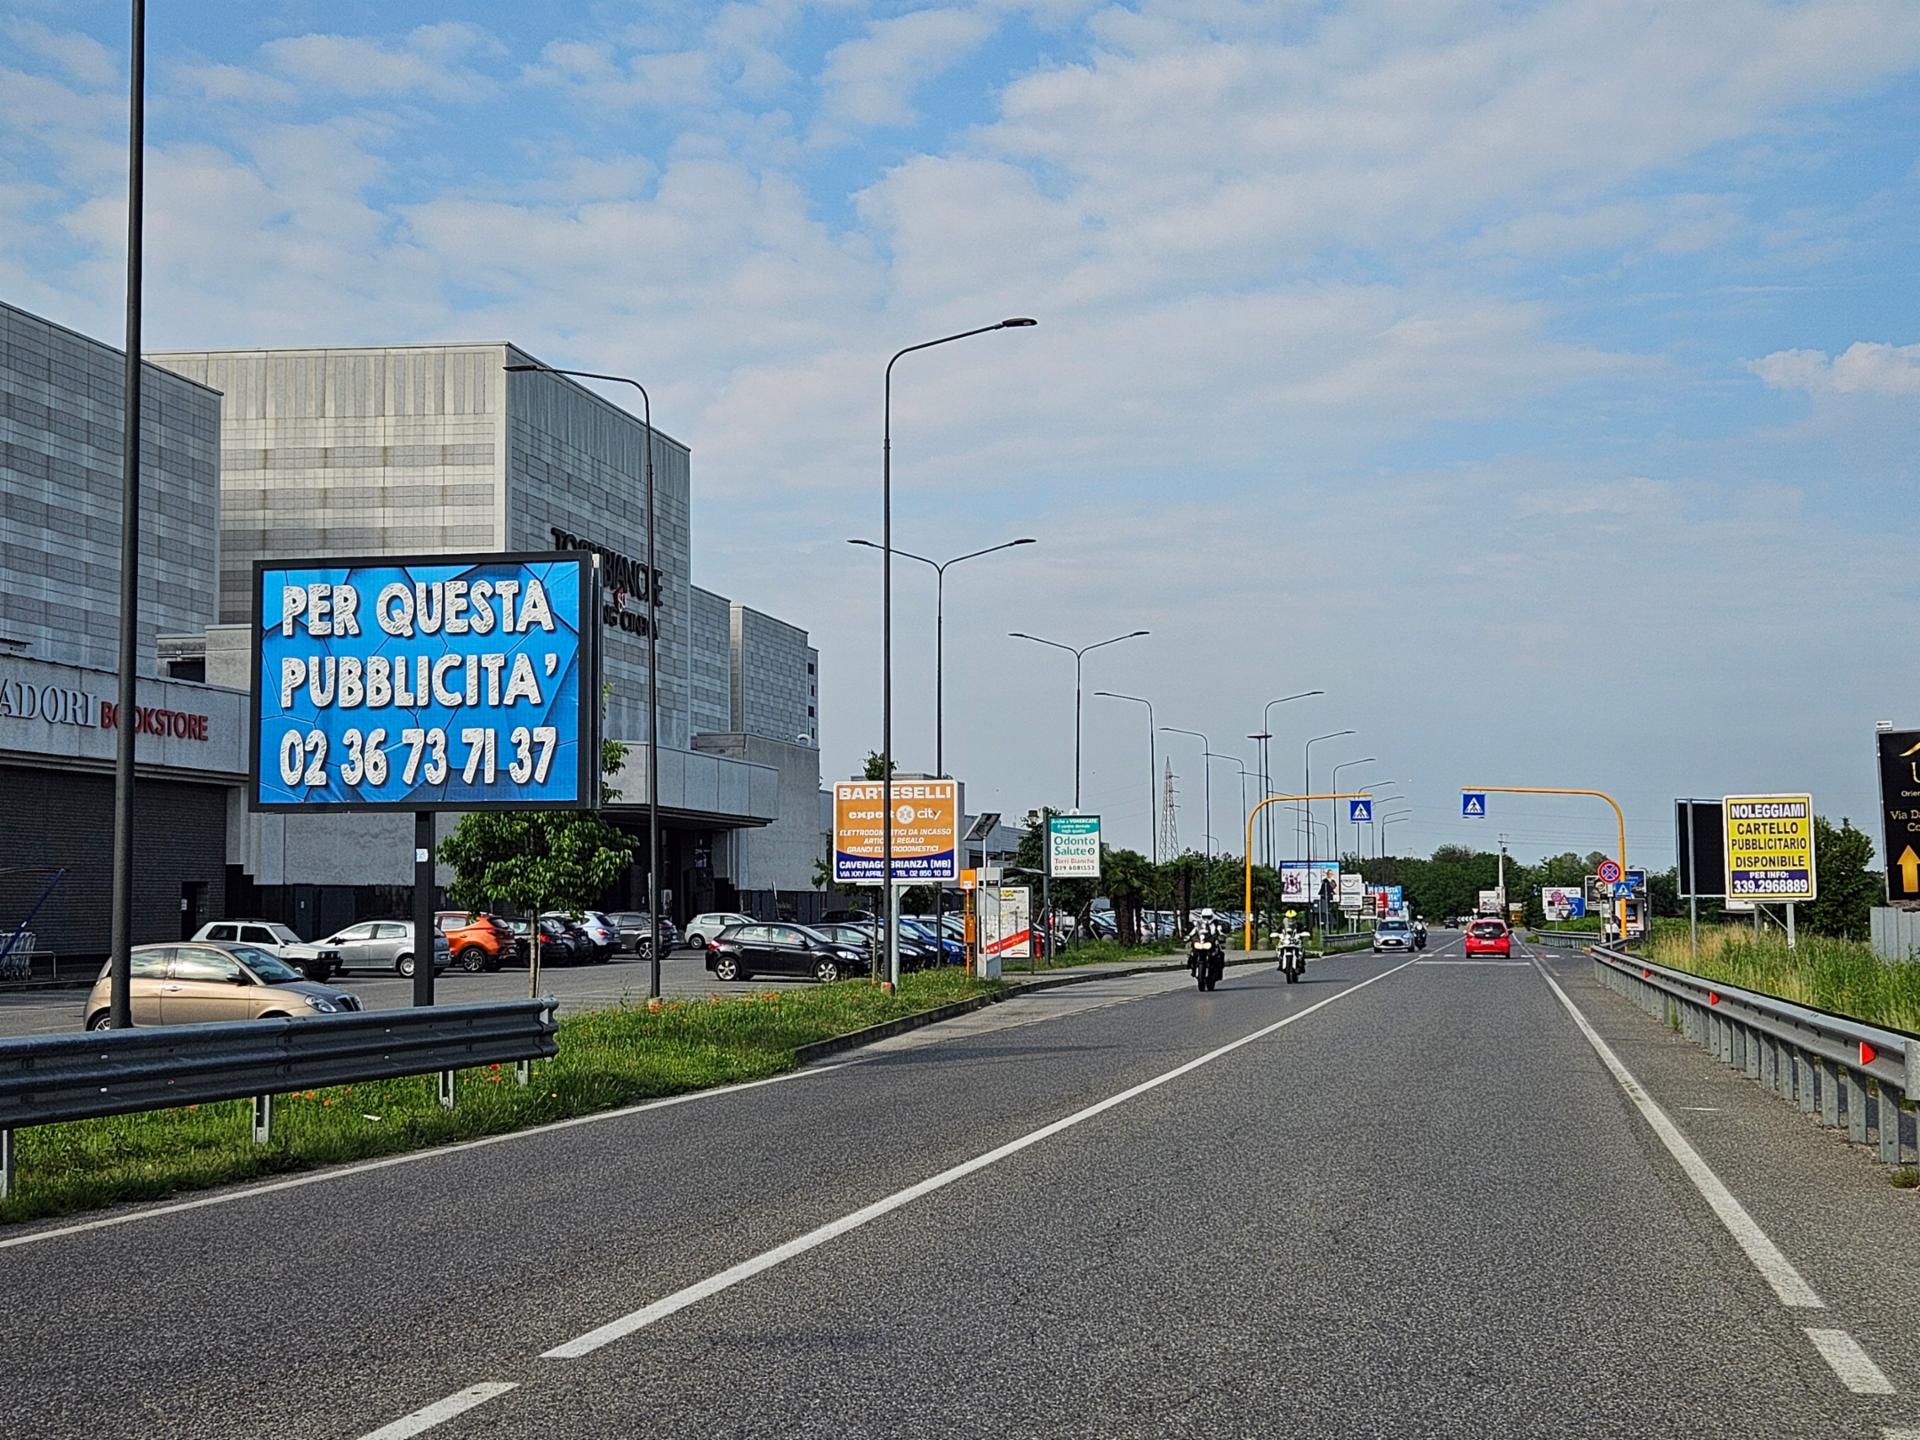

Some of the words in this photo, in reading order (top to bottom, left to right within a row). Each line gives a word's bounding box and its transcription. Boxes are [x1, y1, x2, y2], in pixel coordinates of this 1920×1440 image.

[282, 583, 360, 637] PER
[376, 579, 554, 637] QUESTA
[280, 729, 327, 786] 02
[340, 728, 387, 786] 36
[402, 727, 447, 785] 73
[462, 727, 495, 784] 71
[508, 726, 556, 784] 37
[848, 810, 895, 819] expet
[917, 807, 942, 820] city
[1731, 803, 1805, 818] NOLEGGIAMI
[1890, 810, 1908, 820] Via
[1737, 822, 1799, 835] CARTELLO
[1054, 836, 1096, 845] Odonto
[1731, 838, 1807, 850] PUBBLICITARIO
[1055, 846, 1087, 856] Salute
[890, 860, 929, 868] BRIANZA
[930, 859, 951, 869] (MB)
[1736, 855, 1805, 868] DISPONIBILE
[1733, 879, 1808, 893] 339.2968889
